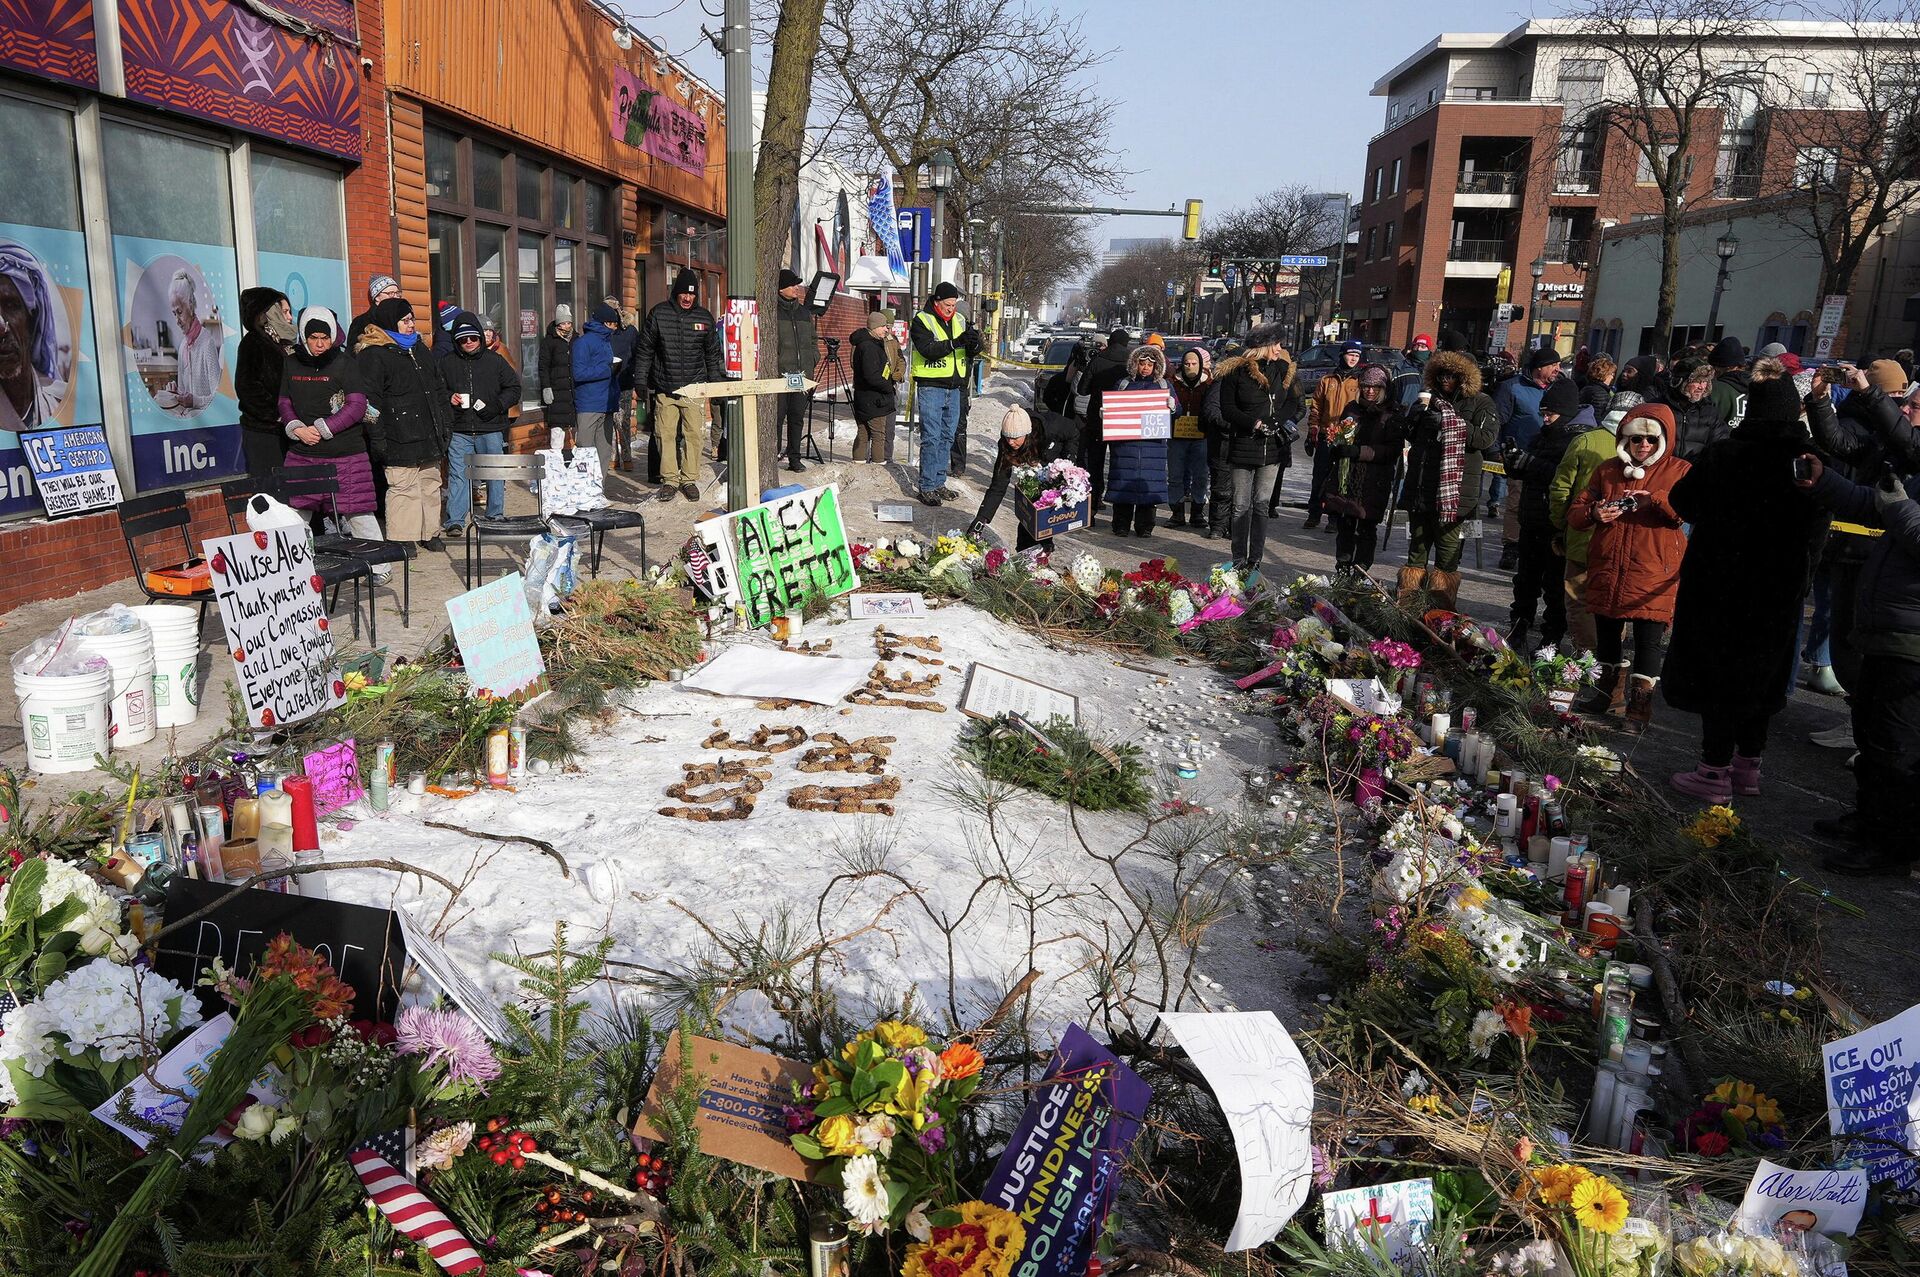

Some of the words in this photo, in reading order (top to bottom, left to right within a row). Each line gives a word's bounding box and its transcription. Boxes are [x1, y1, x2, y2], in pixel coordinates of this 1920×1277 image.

[1545, 283, 1567, 291] Meet
[1569, 284, 1584, 293] Up
[727, 313, 758, 326] DON
[730, 300, 757, 313] SHUT
[923, 359, 947, 369] PRESS
[1143, 426, 1168, 438] OUT
[1144, 413, 1164, 427] ICE
[23, 435, 62, 474] ICE
[63, 429, 105, 449] AMERICAN
[68, 449, 107, 468] GESTAPO
[162, 439, 216, 475] Inc.
[41, 479, 60, 494] THEY
[61, 476, 76, 491] WILL
[75, 476, 87, 487] BE
[89, 472, 106, 484] OUR
[46, 491, 81, 512] GREATEST
[84, 488, 107, 504] SHAME
[741, 499, 828, 560] ALEX
[1047, 510, 1078, 524] chewy
[217, 541, 273, 587] Nurse
[270, 531, 312, 575] Alex
[220, 586, 271, 623] Thank
[269, 587, 289, 615] you
[288, 576, 307, 602] for
[467, 583, 512, 617] PEACE
[748, 545, 850, 624] PRETTI
[230, 624, 267, 656] Your
[458, 617, 499, 650] STEMS
[502, 621, 534, 649] FROM
[243, 654, 270, 680] and
[272, 646, 301, 670] Love
[483, 649, 533, 686] JUSTICE
[246, 671, 302, 710] Everyone
[274, 681, 312, 722] Cared
[1829, 1047, 1861, 1073] ICE
[1870, 1038, 1903, 1067] OUT
[710, 1079, 728, 1091] Call
[739, 1087, 759, 1100] chat
[730, 1073, 753, 1086] Have
[1840, 1077, 1856, 1090] OF
[1841, 1085, 1877, 1108] MNI
[1880, 1070, 1913, 1097] SÓTA
[1000, 1083, 1073, 1212] JUSTICE.
[1020, 1068, 1106, 1224] KINDNESS.
[1066, 1155, 1115, 1245] MARCH
[1333, 1191, 1357, 1206] Alex
[1756, 1172, 1811, 1204] Alex
[1809, 1170, 1863, 1205] Pretti
